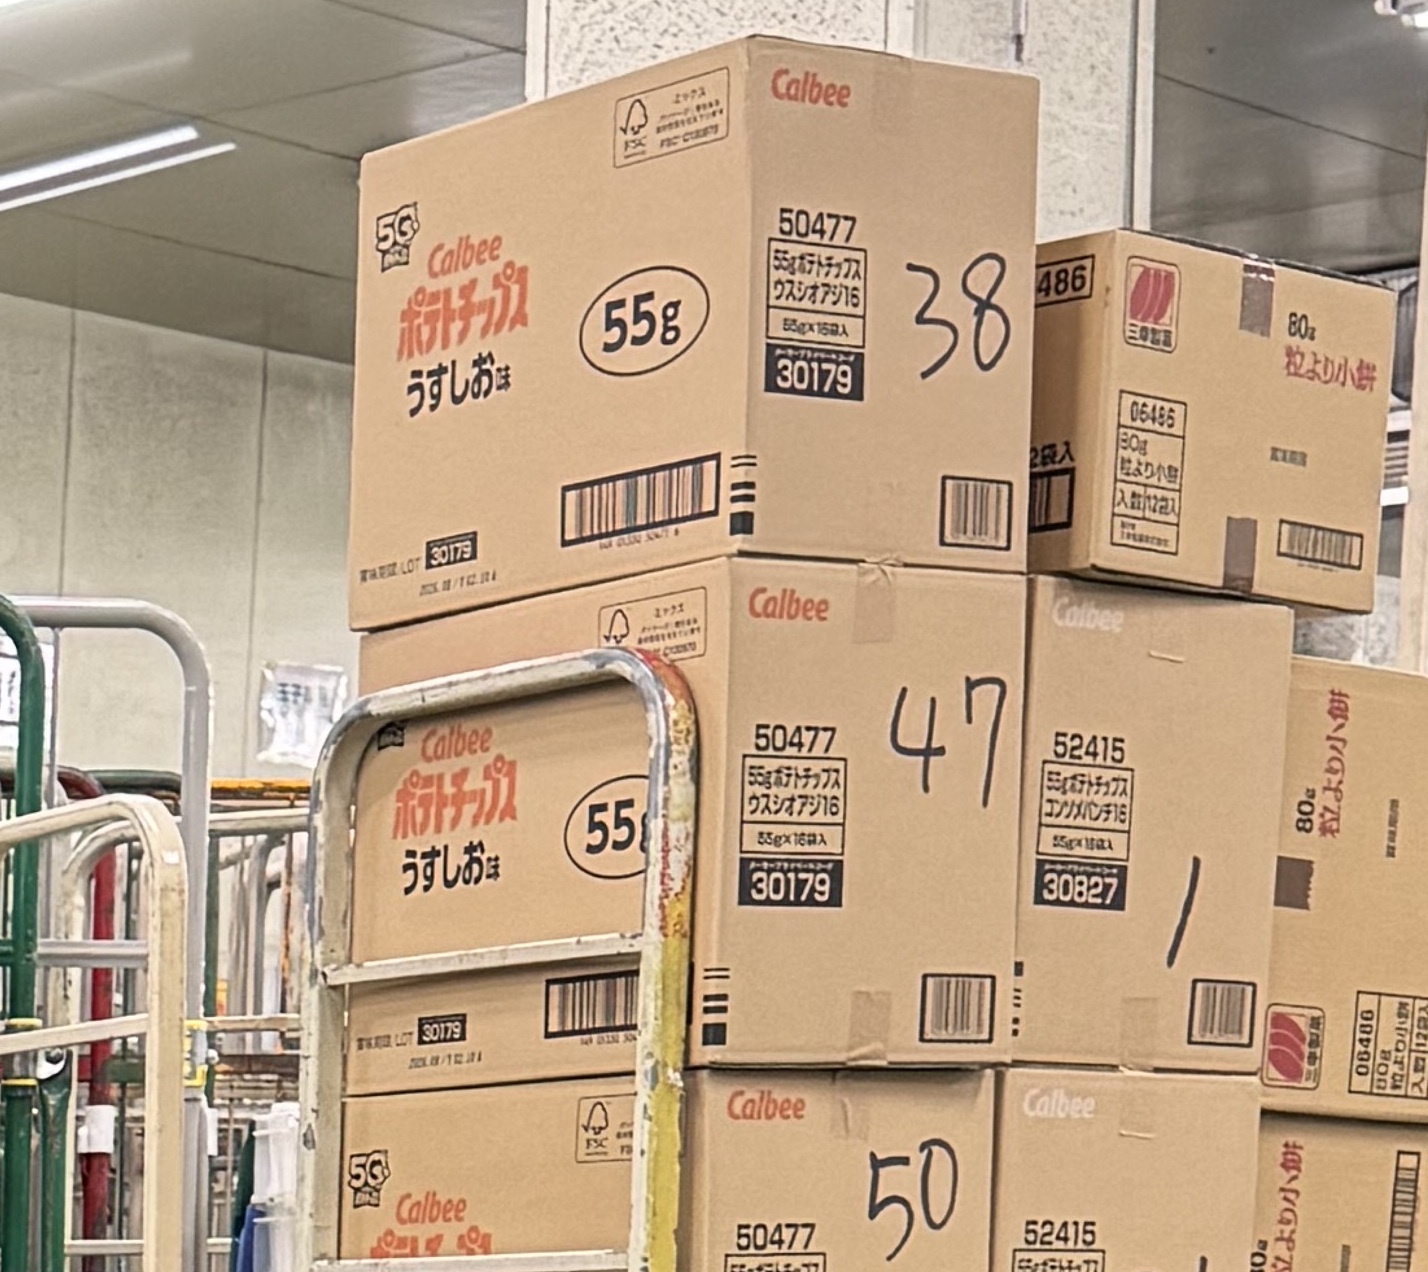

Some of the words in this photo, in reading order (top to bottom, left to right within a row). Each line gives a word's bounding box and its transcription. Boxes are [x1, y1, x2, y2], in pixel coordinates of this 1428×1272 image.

[770, 69, 850, 108] Calbee
[780, 207, 857, 243] 50477
[428, 235, 502, 278] Calbee
[397, 260, 528, 362] ポテトチップス
[774, 278, 860, 308] ウスシオアジ16
[602, 290, 682, 353] 55g
[907, 254, 1010, 379] 38
[407, 351, 511, 418] うすしお味
[776, 359, 852, 394] 30179
[1130, 401, 1175, 428] 06486
[430, 541, 473, 567] 30179
[748, 587, 828, 622] Calbee
[1053, 597, 1125, 633] Calbee
[421, 723, 493, 764] Calbee
[755, 724, 837, 754] 50477
[889, 677, 1007, 806] 47
[1053, 731, 1125, 764] 52415
[392, 753, 517, 841] ポテトチップス
[748, 793, 840, 817] ウスシオアジ16
[1296, 787, 1317, 835] 80g
[585, 798, 648, 855] 55
[402, 840, 500, 896] うすしお味
[750, 871, 831, 902] 30179
[1043, 873, 1118, 905] 30827
[1166, 856, 1201, 968] 1
[422, 1021, 463, 1044] 30179
[726, 1089, 806, 1121] Calbee
[1023, 1087, 1096, 1119] Calbee
[396, 1190, 467, 1226] Calbee
[868, 1138, 958, 1262] 50
[736, 1222, 816, 1251] 50477
[1024, 1219, 1097, 1248] 52415
